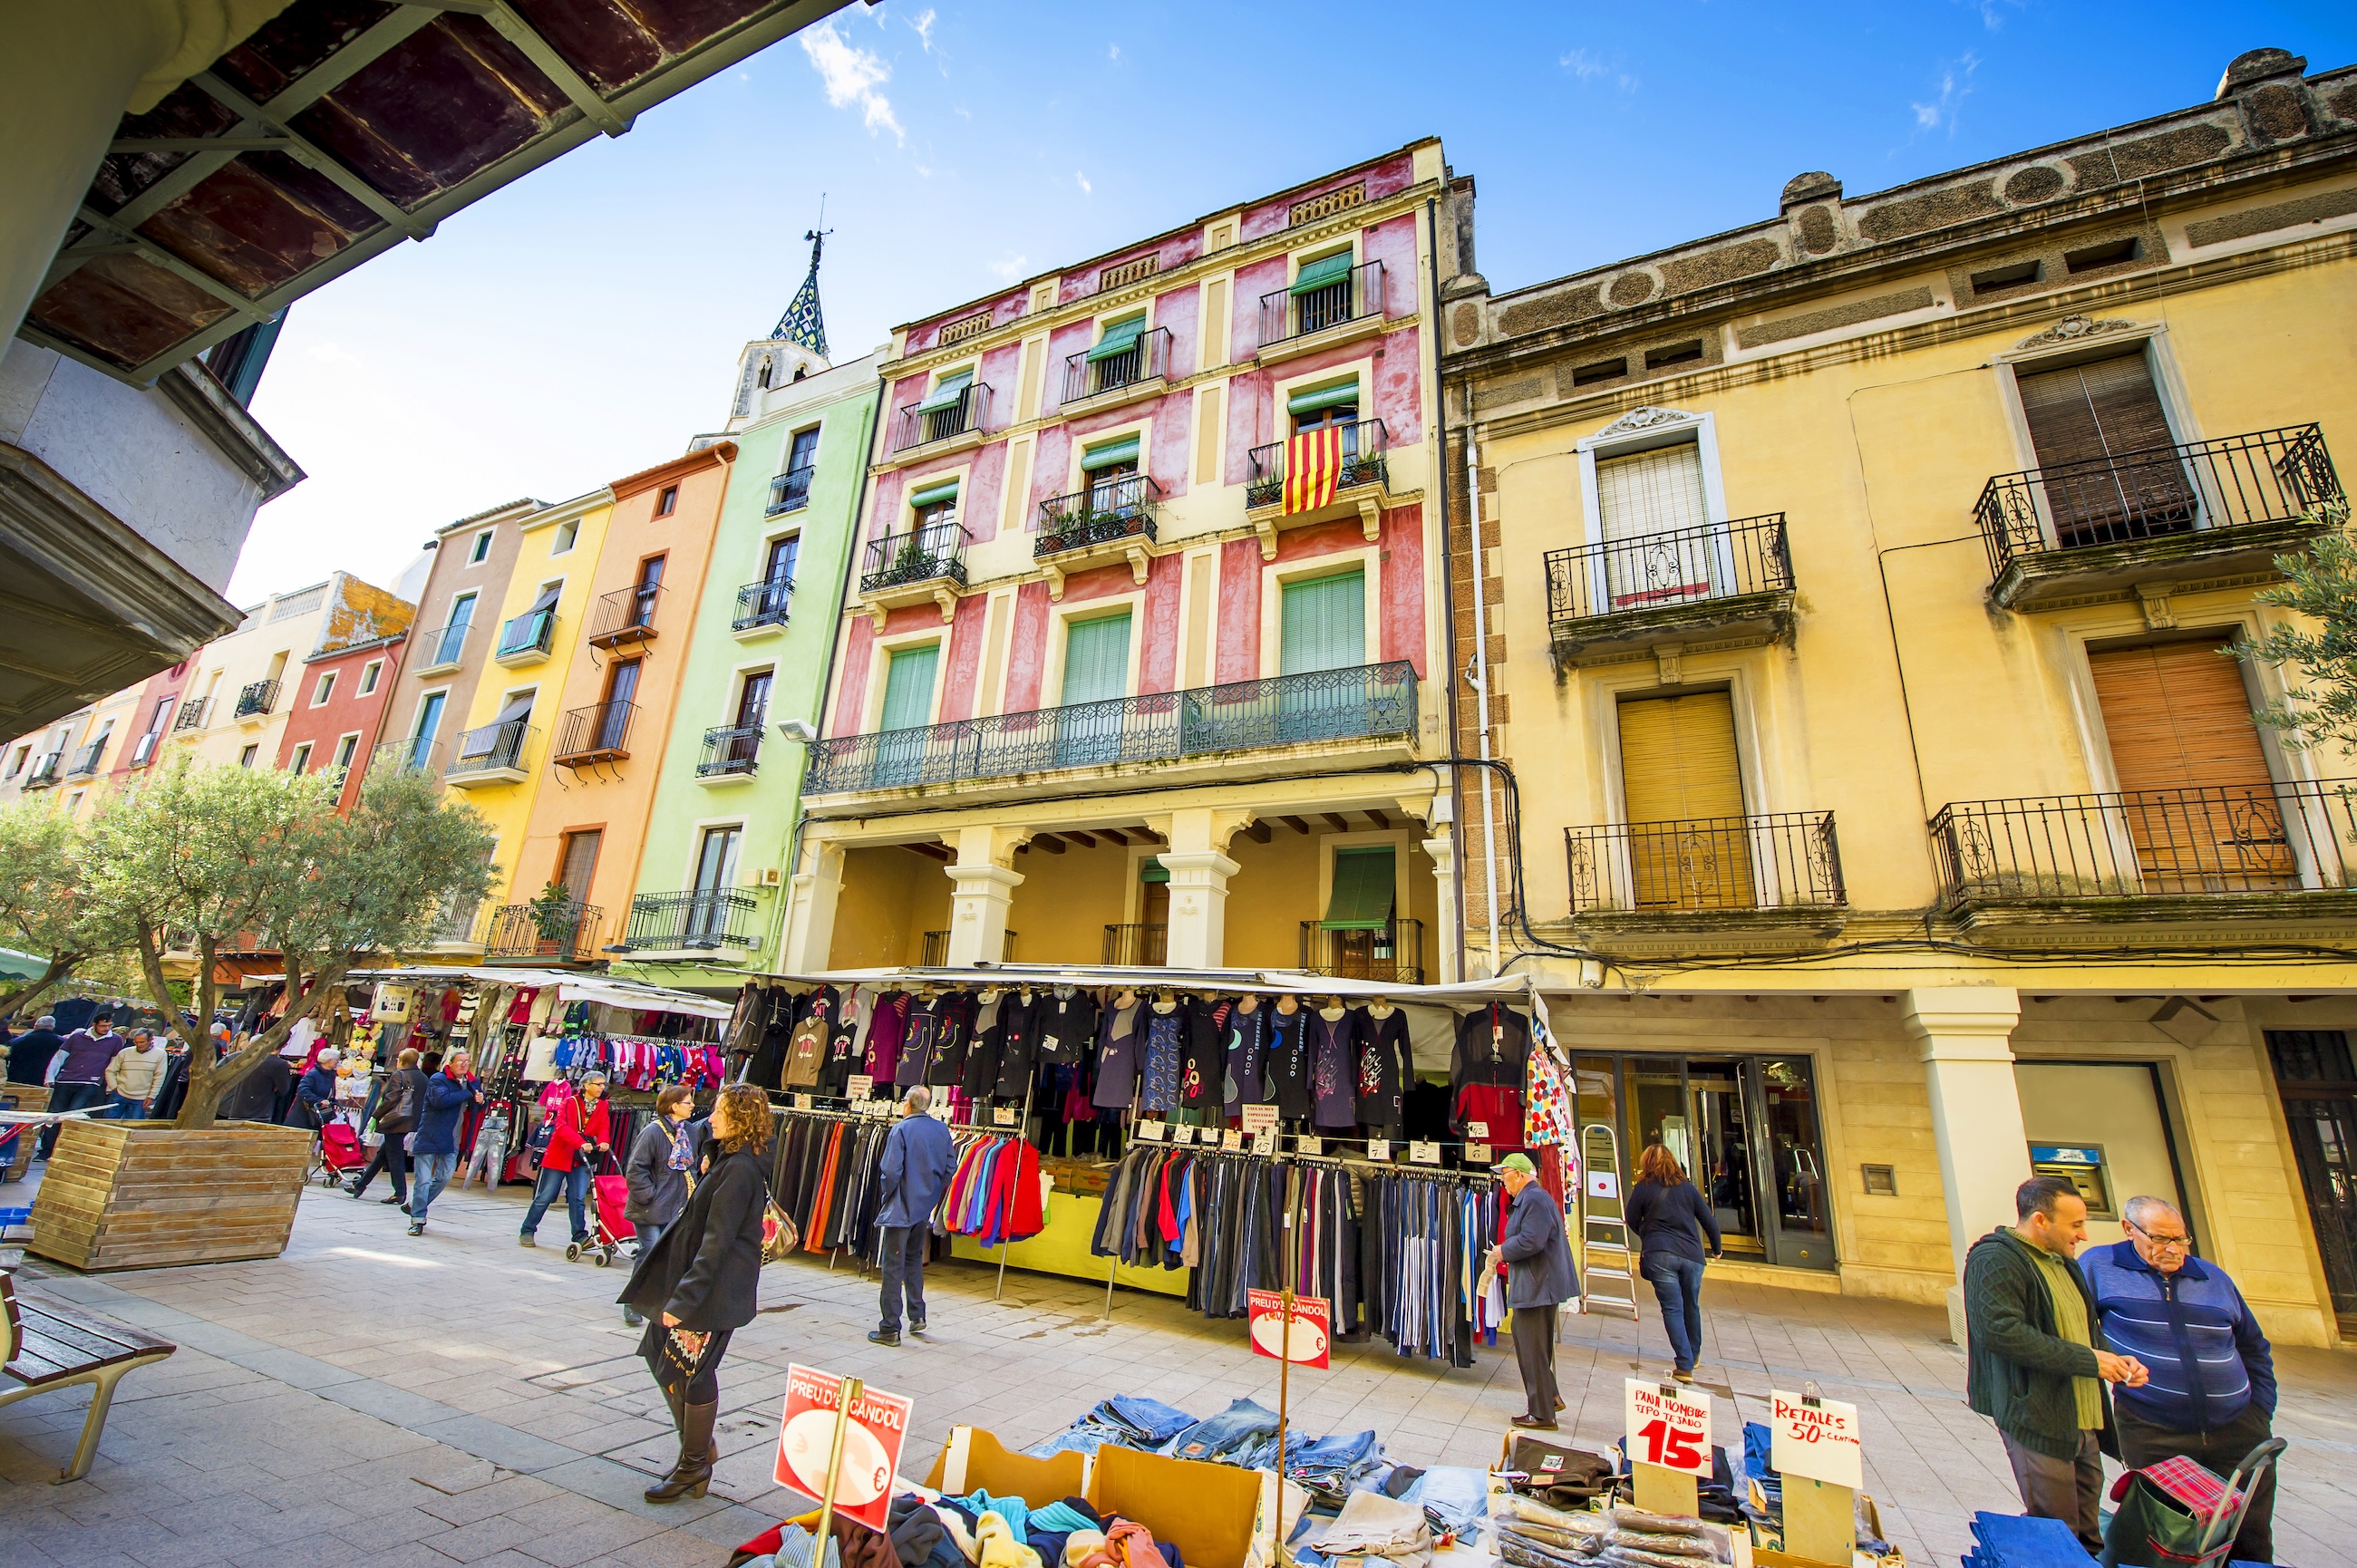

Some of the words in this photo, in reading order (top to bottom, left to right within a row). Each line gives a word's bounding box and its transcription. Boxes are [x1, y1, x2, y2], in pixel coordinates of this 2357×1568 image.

[1250, 1296, 1272, 1309] PREU
[1272, 1301, 1326, 1317] D'ECÀNDOL
[1315, 1337, 1324, 1351] €
[791, 1379, 822, 1401] PREU
[823, 1390, 902, 1430] D'ECÀNDOL
[1635, 1389, 1661, 1408] PANA
[1634, 1404, 1660, 1417] TIPO
[1774, 1399, 1846, 1429] RETALES
[873, 1466, 887, 1492] €
